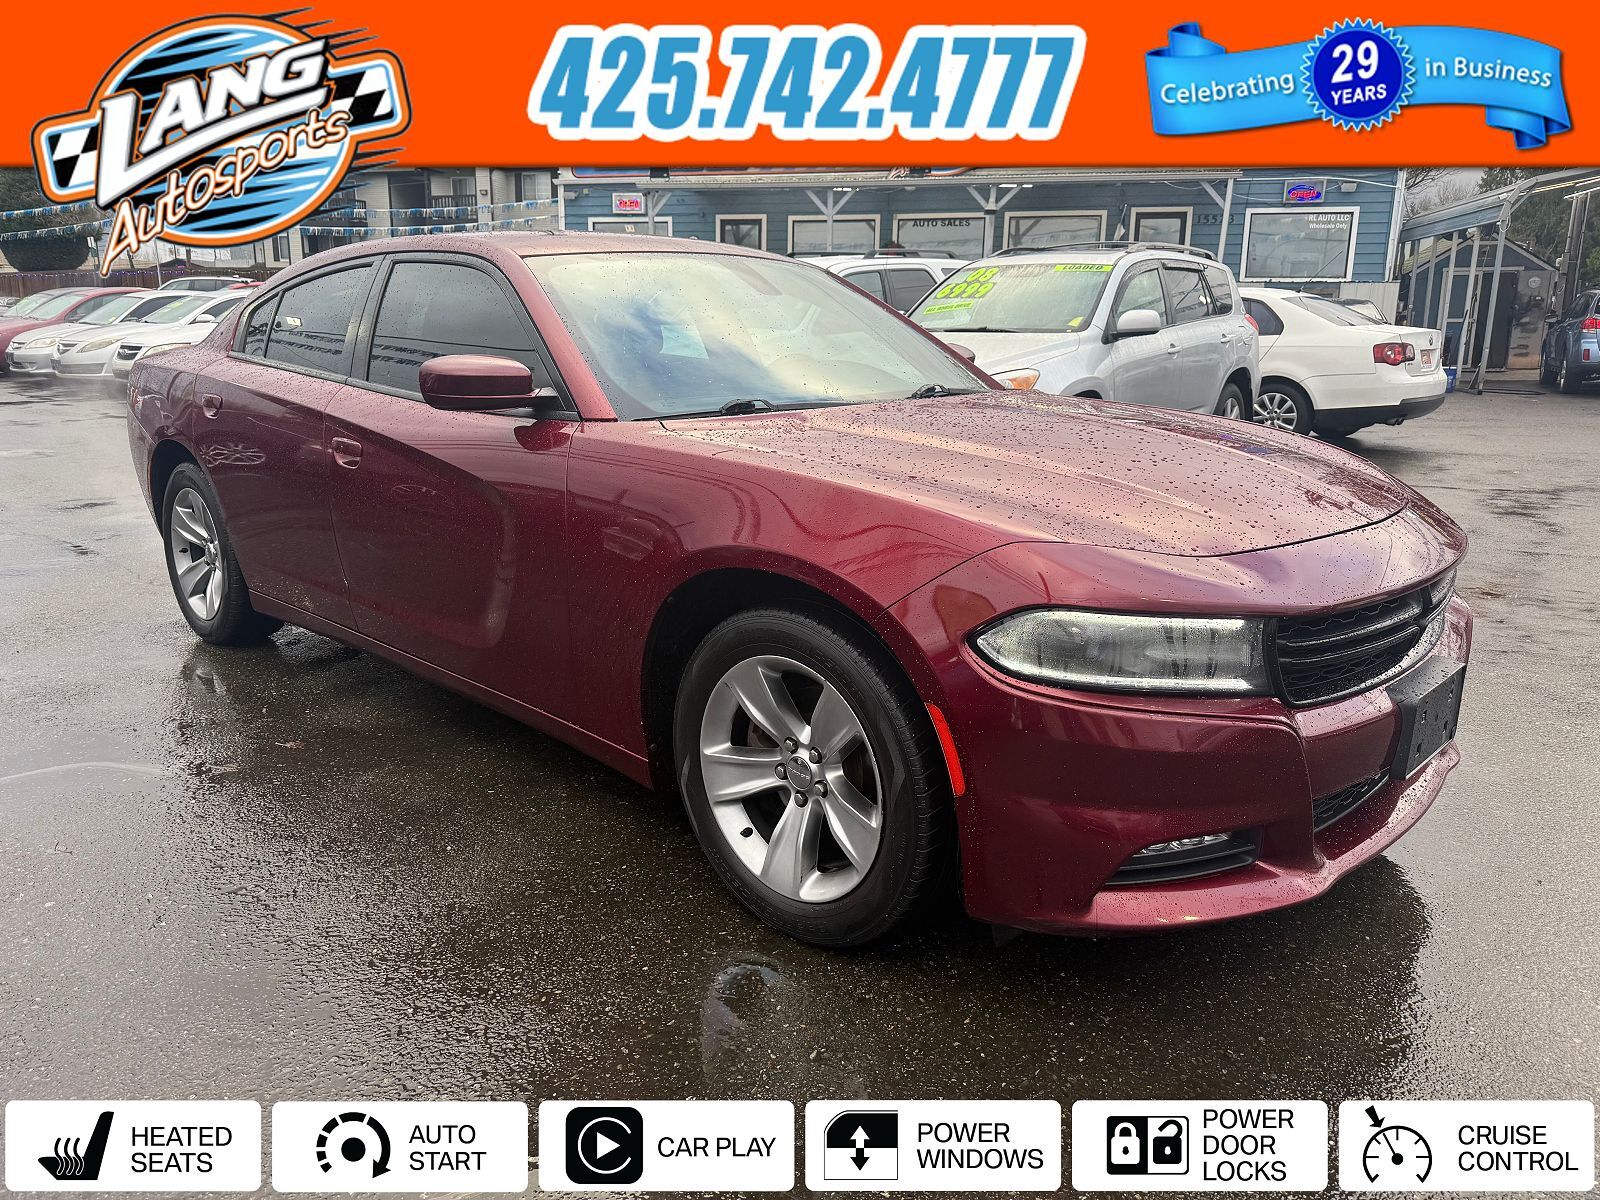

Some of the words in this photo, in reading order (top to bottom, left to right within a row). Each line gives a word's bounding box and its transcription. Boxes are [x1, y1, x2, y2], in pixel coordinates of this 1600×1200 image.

[1290, 190, 1318, 199] OPEN
[1318, 214, 1336, 222] AUTO
[912, 219, 938, 228] AUTO
[940, 219, 971, 227] SALES
[936, 282, 995, 299] 6999
